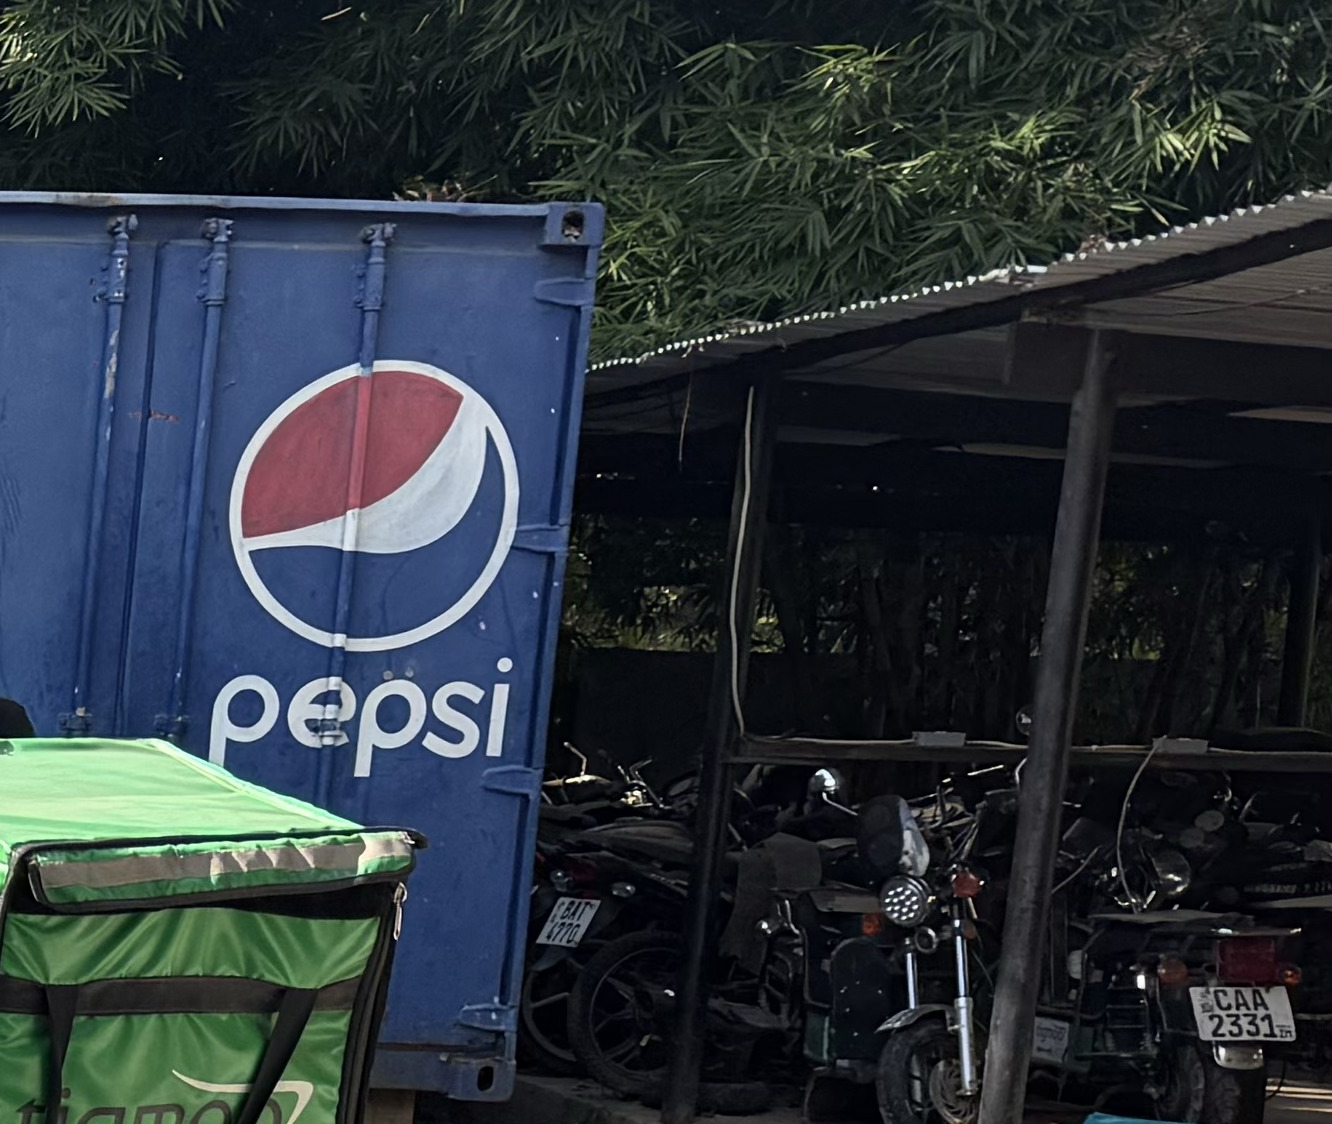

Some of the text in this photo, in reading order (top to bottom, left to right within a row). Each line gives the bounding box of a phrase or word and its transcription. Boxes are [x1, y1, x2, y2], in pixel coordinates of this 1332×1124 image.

[208, 656, 514, 778] pepsi
[1213, 988, 1270, 1012] CAA
[1208, 1013, 1278, 1038] 2331
